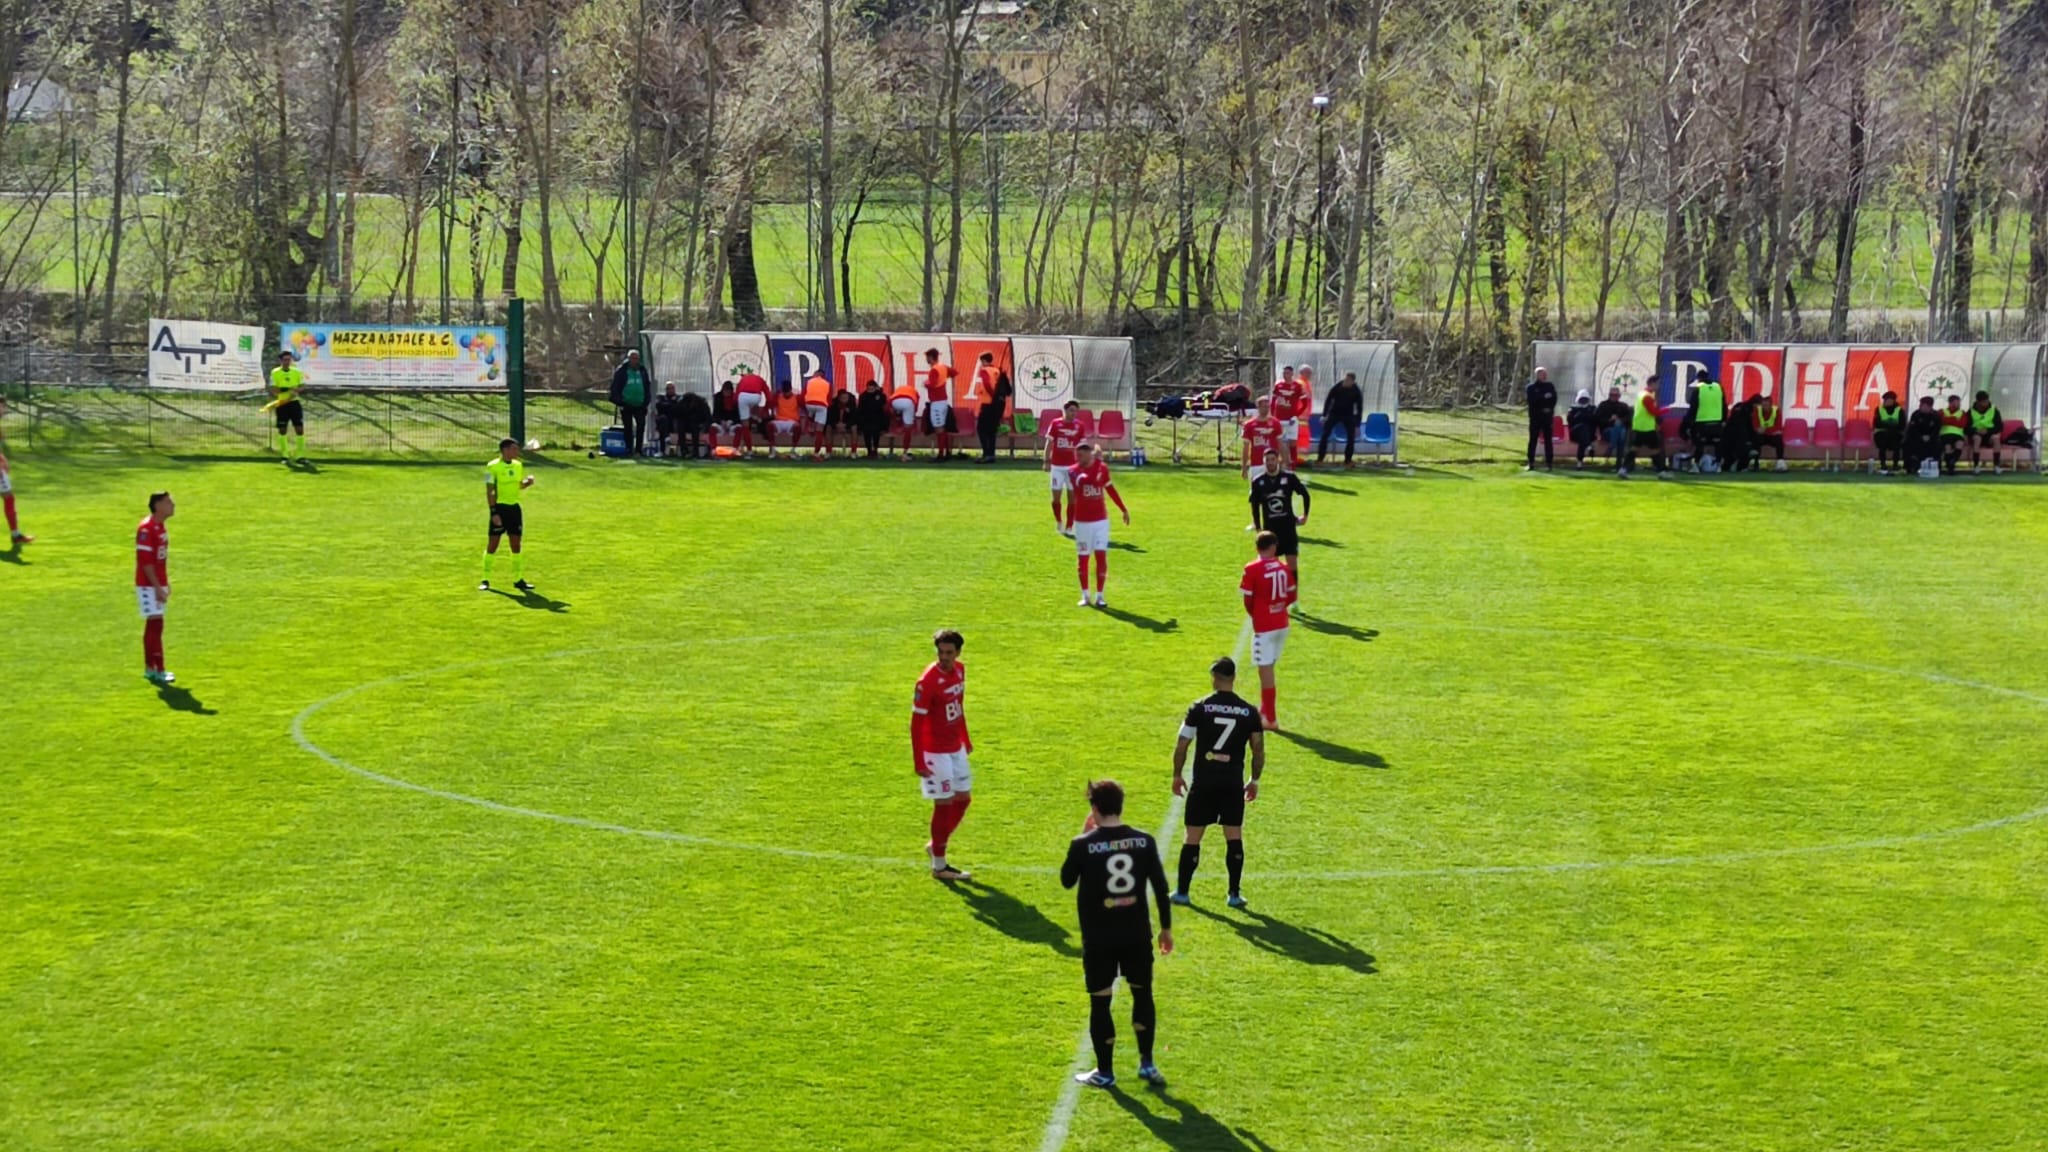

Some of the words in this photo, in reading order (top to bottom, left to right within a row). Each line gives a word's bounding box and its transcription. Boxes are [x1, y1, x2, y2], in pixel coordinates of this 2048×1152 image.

[333, 346, 373, 356] articoli
[377, 347, 454, 358] promozionali
[379, 333, 425, 346] NATALE
[428, 334, 437, 346] &
[1264, 570, 1288, 600] 70
[1213, 717, 1237, 750] 7
[1106, 853, 1135, 893] 8
